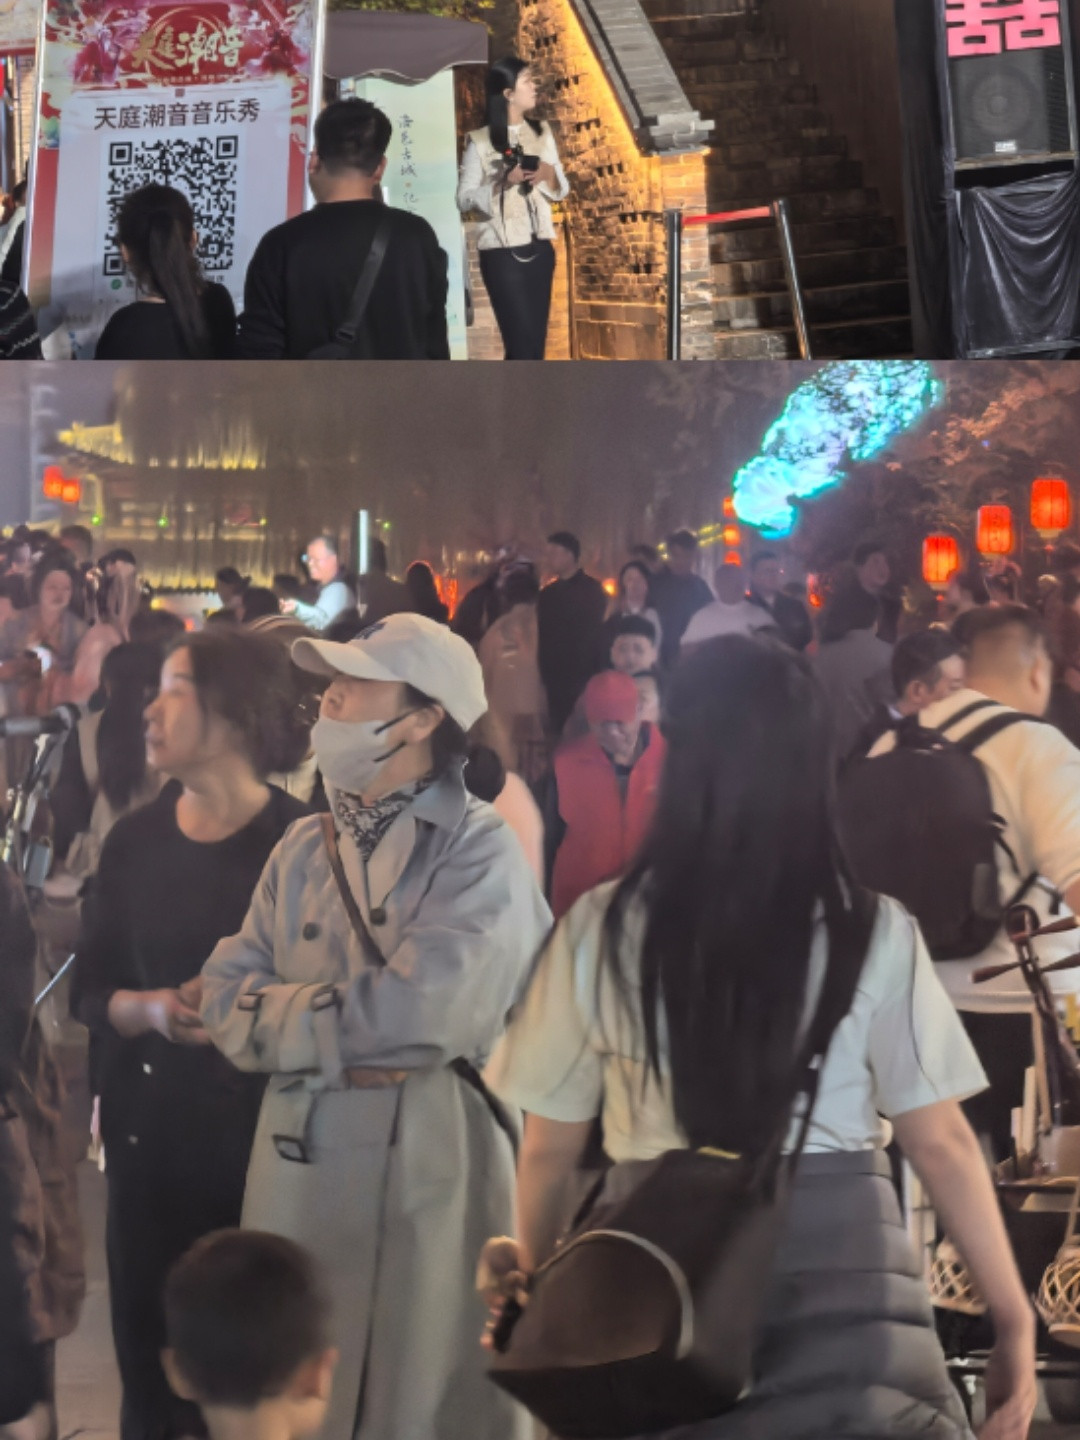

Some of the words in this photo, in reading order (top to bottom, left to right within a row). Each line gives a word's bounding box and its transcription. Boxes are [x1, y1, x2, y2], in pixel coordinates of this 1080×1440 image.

[94, 98, 260, 130] 天庭潮音音乐秀
